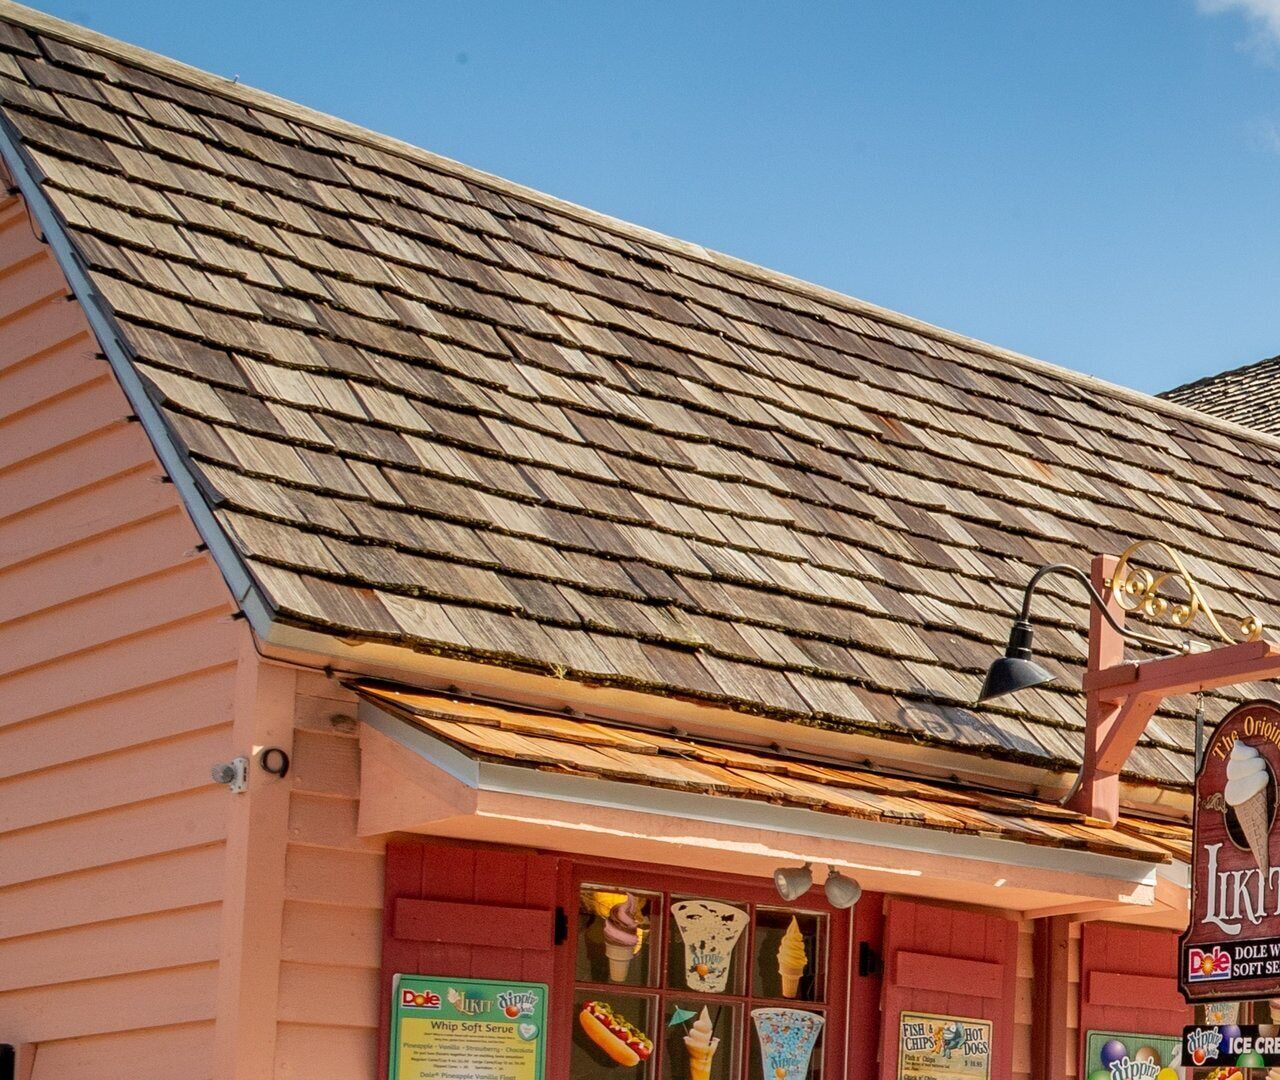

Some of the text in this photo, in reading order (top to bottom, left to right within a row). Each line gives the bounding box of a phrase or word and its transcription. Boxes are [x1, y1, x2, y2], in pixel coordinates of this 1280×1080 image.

[1212, 730, 1239, 761] The
[1190, 946, 1230, 974] Dole
[1235, 946, 1267, 960] DOLE
[1233, 962, 1264, 977] SOFT
[403, 989, 440, 1006] Dole
[431, 1021, 514, 1034] Whip Soft Serve
[903, 1023, 933, 1037] FISH &
[965, 1028, 983, 1041] HOT
[905, 1036, 934, 1051] CHIPS
[965, 1042, 988, 1055] DOGS
[1229, 1037, 1251, 1054] ICE
